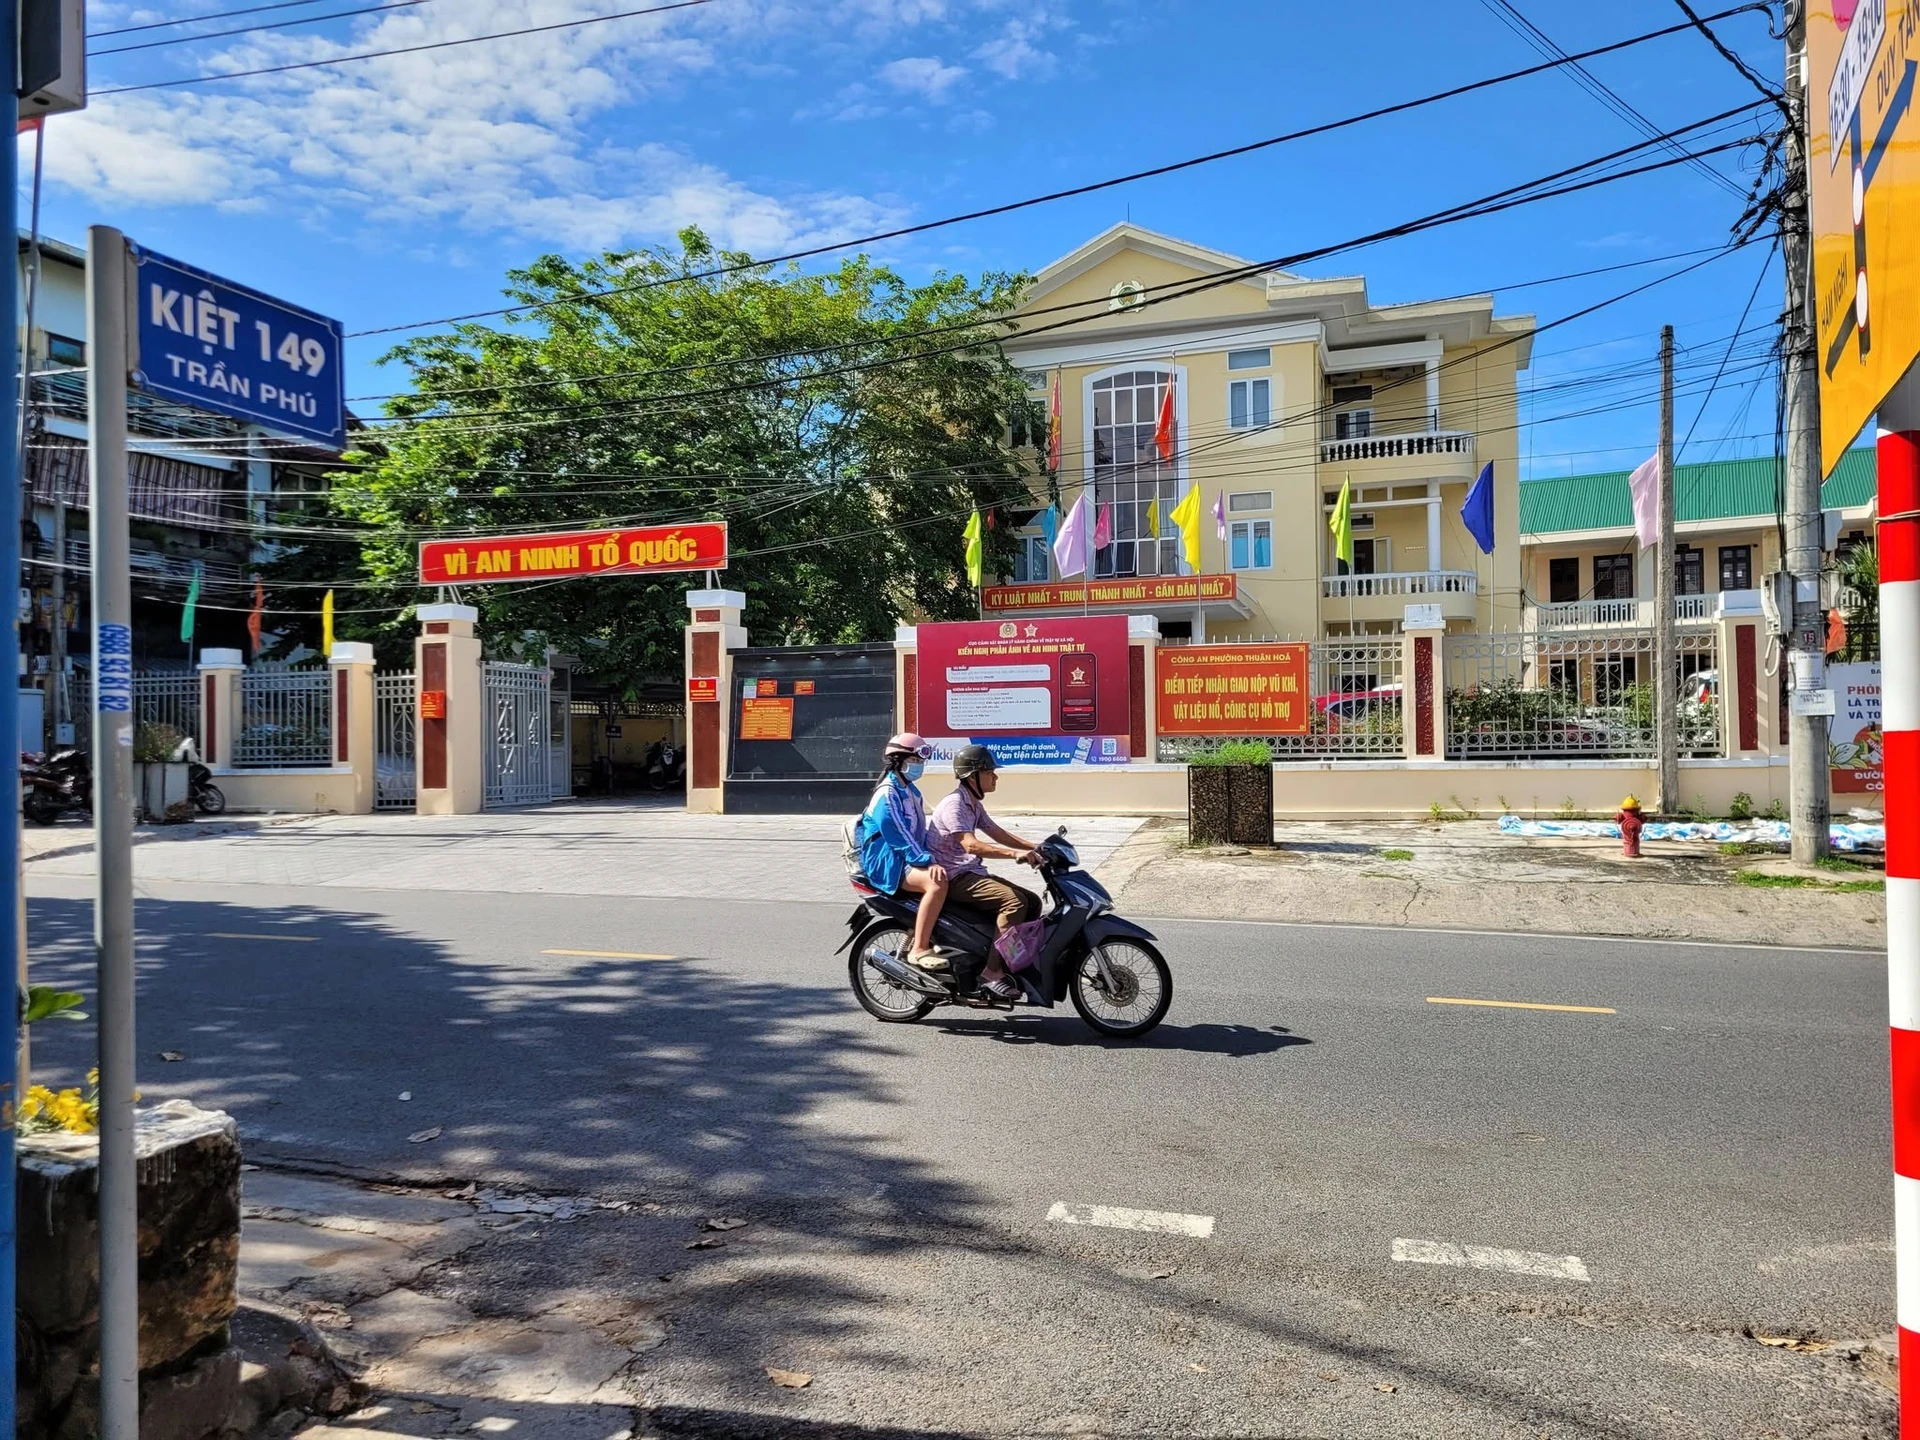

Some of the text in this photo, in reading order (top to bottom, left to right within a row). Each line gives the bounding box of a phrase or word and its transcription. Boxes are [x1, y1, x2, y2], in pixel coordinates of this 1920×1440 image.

[1877, 34, 1896, 114] DUY
[1830, 58, 1850, 150] 16:30
[151, 283, 326, 378] KIỆT 149
[166, 353, 317, 417] TRẦN PHÚ
[444, 531, 697, 575] VÌ AN NINH TỔ QUỐC
[1005, 591, 1026, 607] LUẬT
[1028, 588, 1050, 604] NHẤT
[1059, 589, 1087, 603] TRUNG
[1090, 586, 1120, 600] THÀNH
[1123, 583, 1146, 599] NHẤT
[1177, 582, 1197, 596] DÂN
[1200, 579, 1224, 595] NHẤT
[1803, 632, 1815, 644] 15
[1171, 655, 1195, 663] CÔNG
[1210, 653, 1243, 662] PHƯỜNG
[1245, 652, 1271, 663] THUẬN
[1273, 652, 1291, 660] HOÁ
[1186, 673, 1204, 694] TIẾP
[1205, 674, 1228, 697] NHẬN
[1230, 676, 1249, 693] GIAO
[1250, 673, 1267, 696] NỘP
[1269, 673, 1280, 692] VŨ
[1282, 672, 1299, 694] KHÍ,
[1847, 683, 1881, 695] PHÒN
[1848, 697, 1881, 707] LÀ TR
[1174, 696, 1290, 722] VẬT LIỆU NỔ, CÔNG CỤ HỖ TRỢ
[1848, 710, 1881, 719] VÀ TO
[987, 743, 1000, 752] Một
[1001, 744, 1020, 752] chạm
[1038, 742, 1056, 750] danh
[996, 751, 1012, 761] Vạn
[1013, 751, 1030, 761] tiện
[1031, 750, 1044, 759] ích
[1045, 749, 1060, 759] mở
[1854, 770, 1884, 780] ĐƯỜ
[1865, 781, 1884, 790] CÔ
